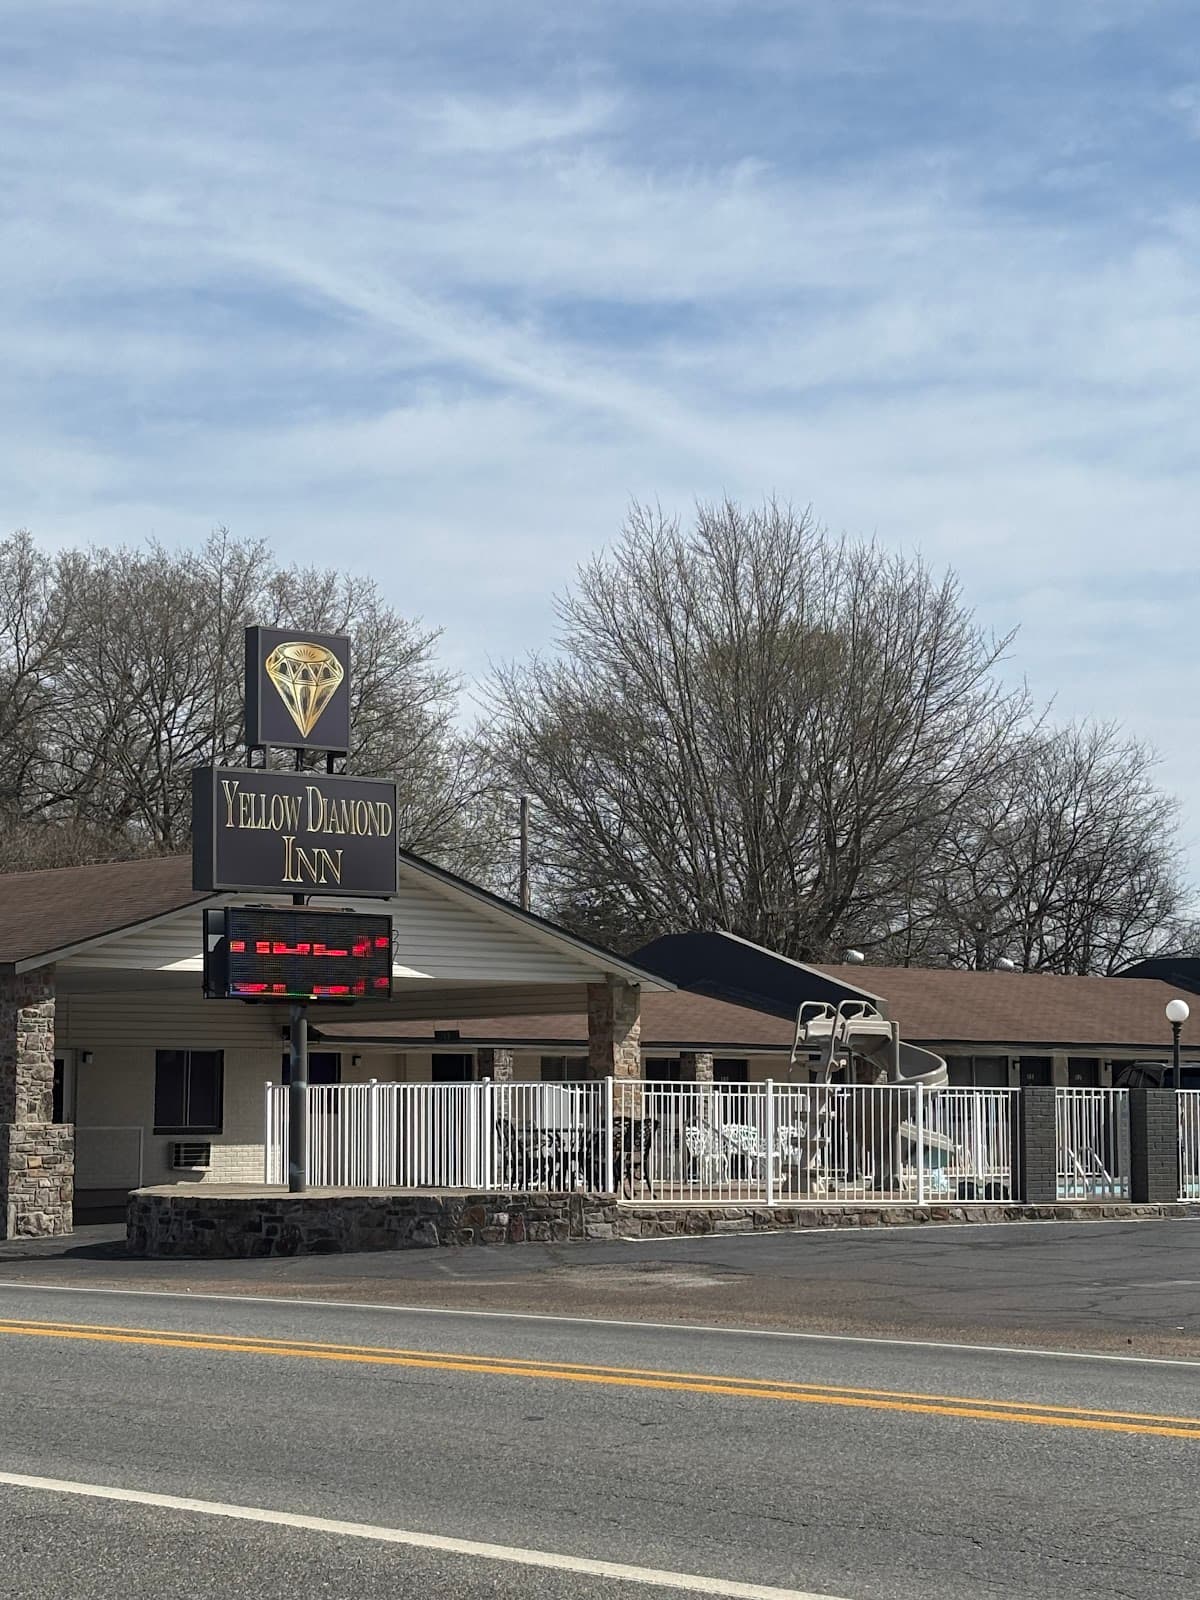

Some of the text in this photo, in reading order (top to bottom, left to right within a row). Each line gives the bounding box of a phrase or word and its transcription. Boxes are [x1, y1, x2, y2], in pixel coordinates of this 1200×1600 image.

[221, 780, 392, 837] YELLOW DIAMOND
[281, 835, 343, 885] INN
